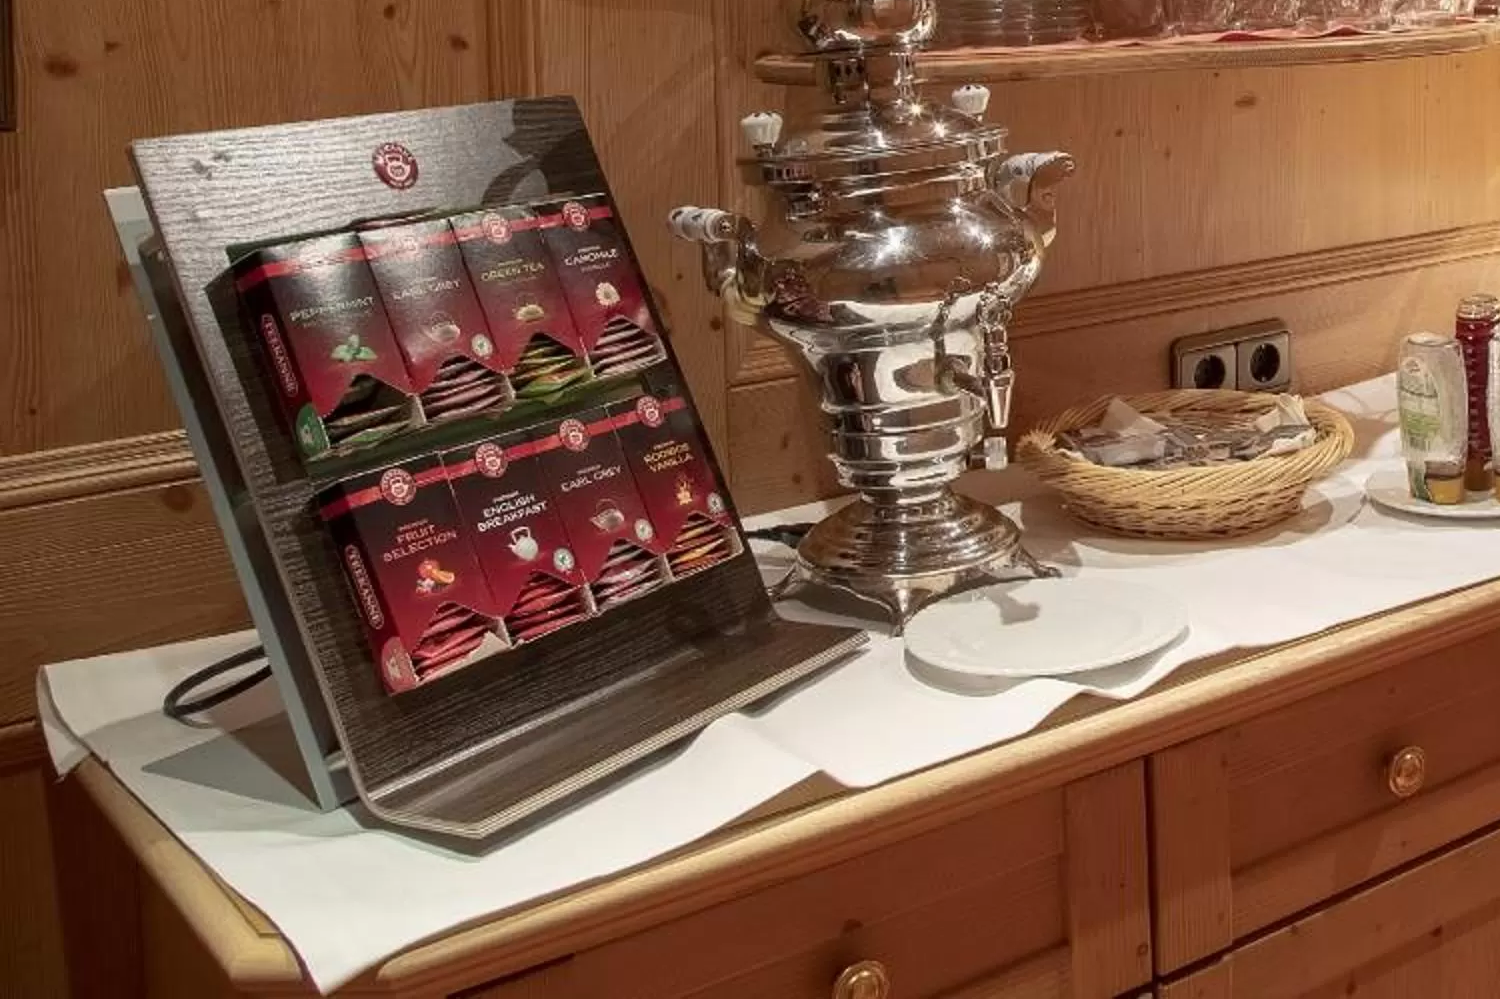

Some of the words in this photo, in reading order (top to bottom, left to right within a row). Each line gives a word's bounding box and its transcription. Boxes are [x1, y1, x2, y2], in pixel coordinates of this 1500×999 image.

[477, 500, 548, 533] BREAKFAST
[383, 529, 457, 563] SELECTION
[395, 524, 435, 545] FRUIT
